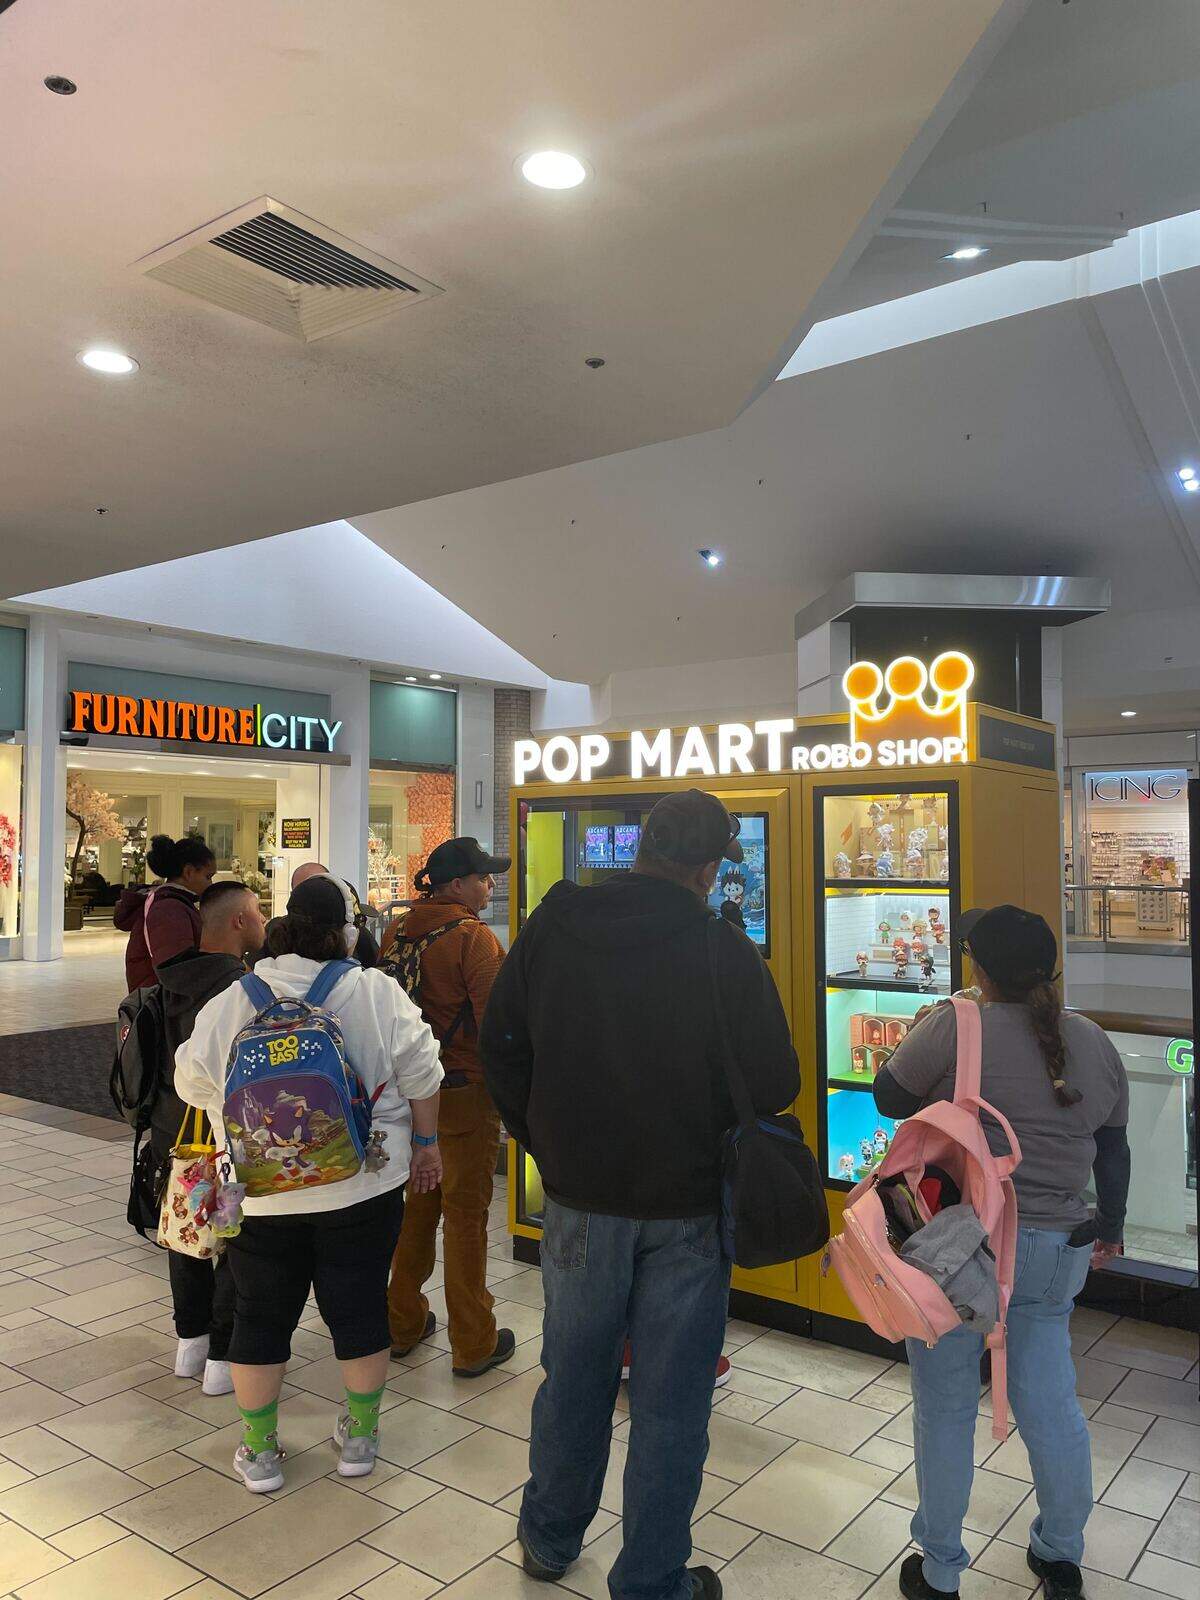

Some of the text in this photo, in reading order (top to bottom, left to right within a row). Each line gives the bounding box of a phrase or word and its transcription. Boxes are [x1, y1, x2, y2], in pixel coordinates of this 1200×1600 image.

[71, 690, 343, 752] FURNITURE CITY
[513, 733, 611, 786] POP
[630, 718, 795, 779] MART
[791, 741, 872, 771] ROBO
[877, 736, 968, 768] SHOP
[1090, 774, 1182, 801] ICING
[266, 1035, 298, 1053] TOO
[269, 1047, 299, 1066] EASY
